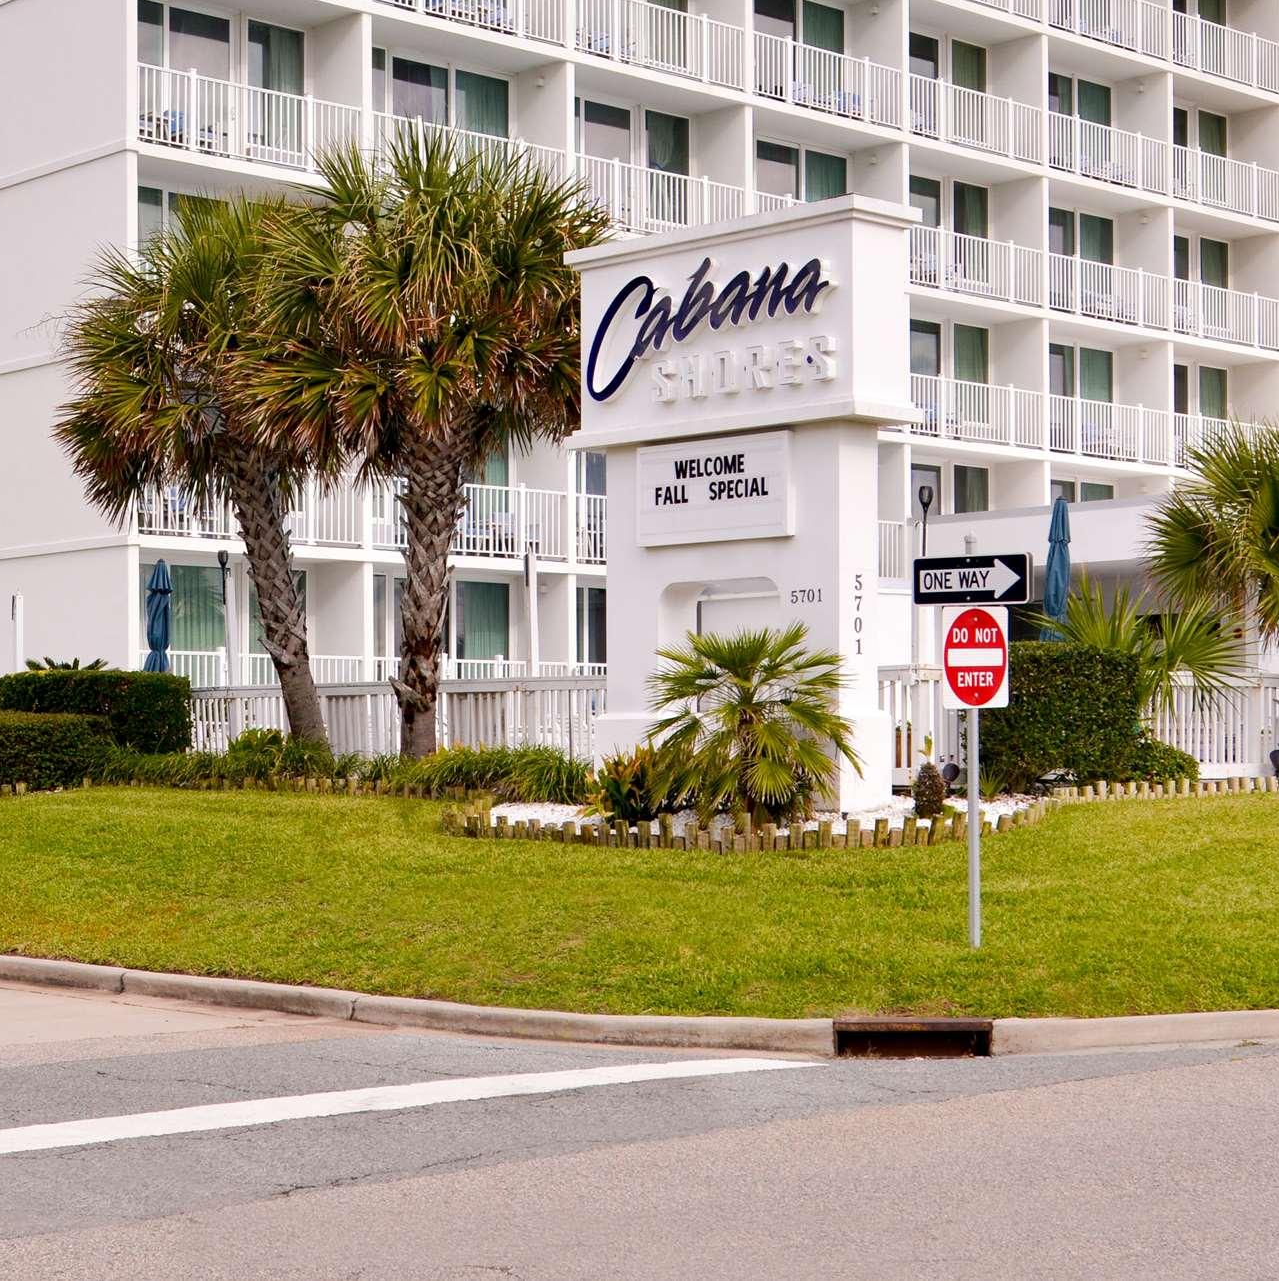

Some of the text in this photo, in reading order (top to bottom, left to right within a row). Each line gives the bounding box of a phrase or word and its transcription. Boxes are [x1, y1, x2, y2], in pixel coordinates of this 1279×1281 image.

[587, 256, 829, 402] Cabana
[653, 335, 838, 403] SHORES
[675, 454, 745, 479] WELCOME
[655, 477, 768, 506] FALL SPECIAL
[923, 570, 990, 590] ONE WAY
[791, 588, 823, 604] 5701
[952, 628, 998, 643] DO NOT
[957, 672, 994, 687] ENTER
